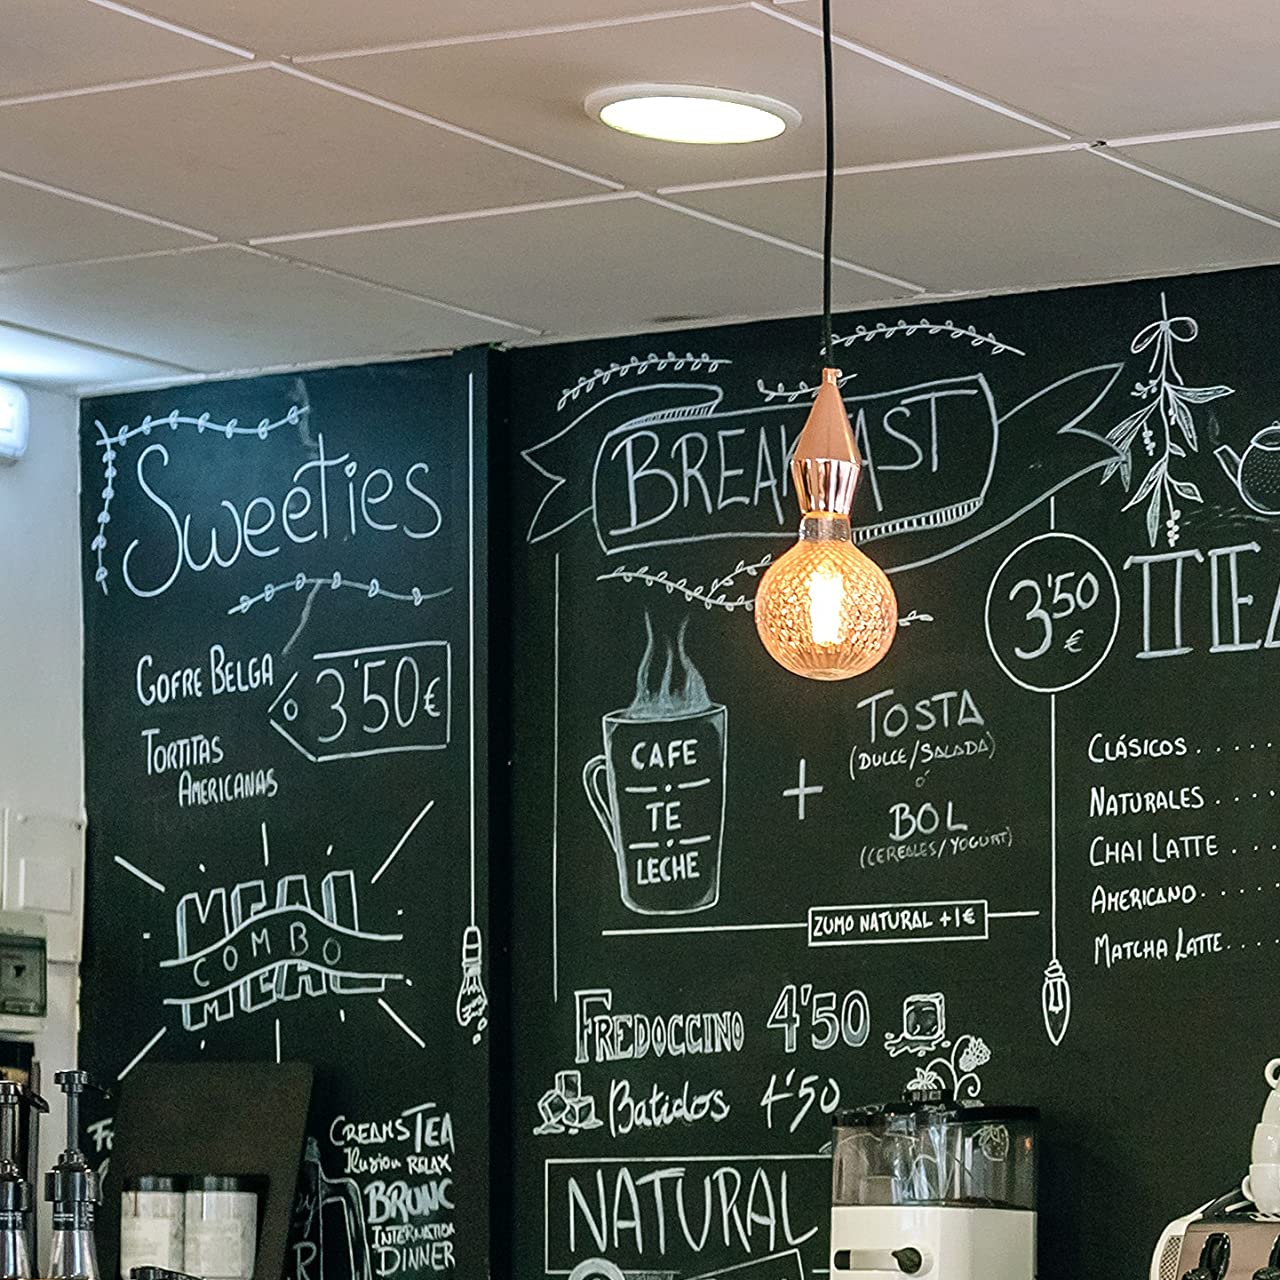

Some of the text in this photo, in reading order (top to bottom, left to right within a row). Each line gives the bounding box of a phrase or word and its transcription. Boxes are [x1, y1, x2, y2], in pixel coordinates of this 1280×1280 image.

[122, 433, 443, 597] Sweeties
[857, 689, 984, 743] TOSTA
[631, 738, 699, 770] CAFE
[646, 802, 682, 832] TE
[1090, 786, 1205, 817] NATURALES
[889, 801, 968, 841] BOL
[636, 851, 700, 885] LECHE
[1090, 836, 1142, 866] CHAI
[1153, 833, 1219, 863] LATTE
[1091, 885, 1197, 913] AMERICANO
[813, 915, 854, 937] ZUMO
[860, 910, 934, 933] NATURAL
[193, 921, 342, 988] COMBO
[1095, 933, 1168, 968] MATCHA
[1176, 927, 1223, 962] LATTE
[574, 988, 745, 1064] FREDOCCINO
[609, 1078, 730, 1137] Batidos
[401, 1102, 455, 1155] TEA
[406, 1154, 452, 1175] RELAX
[568, 1167, 818, 1255] NATURAL
[376, 1240, 456, 1277] DINNER
